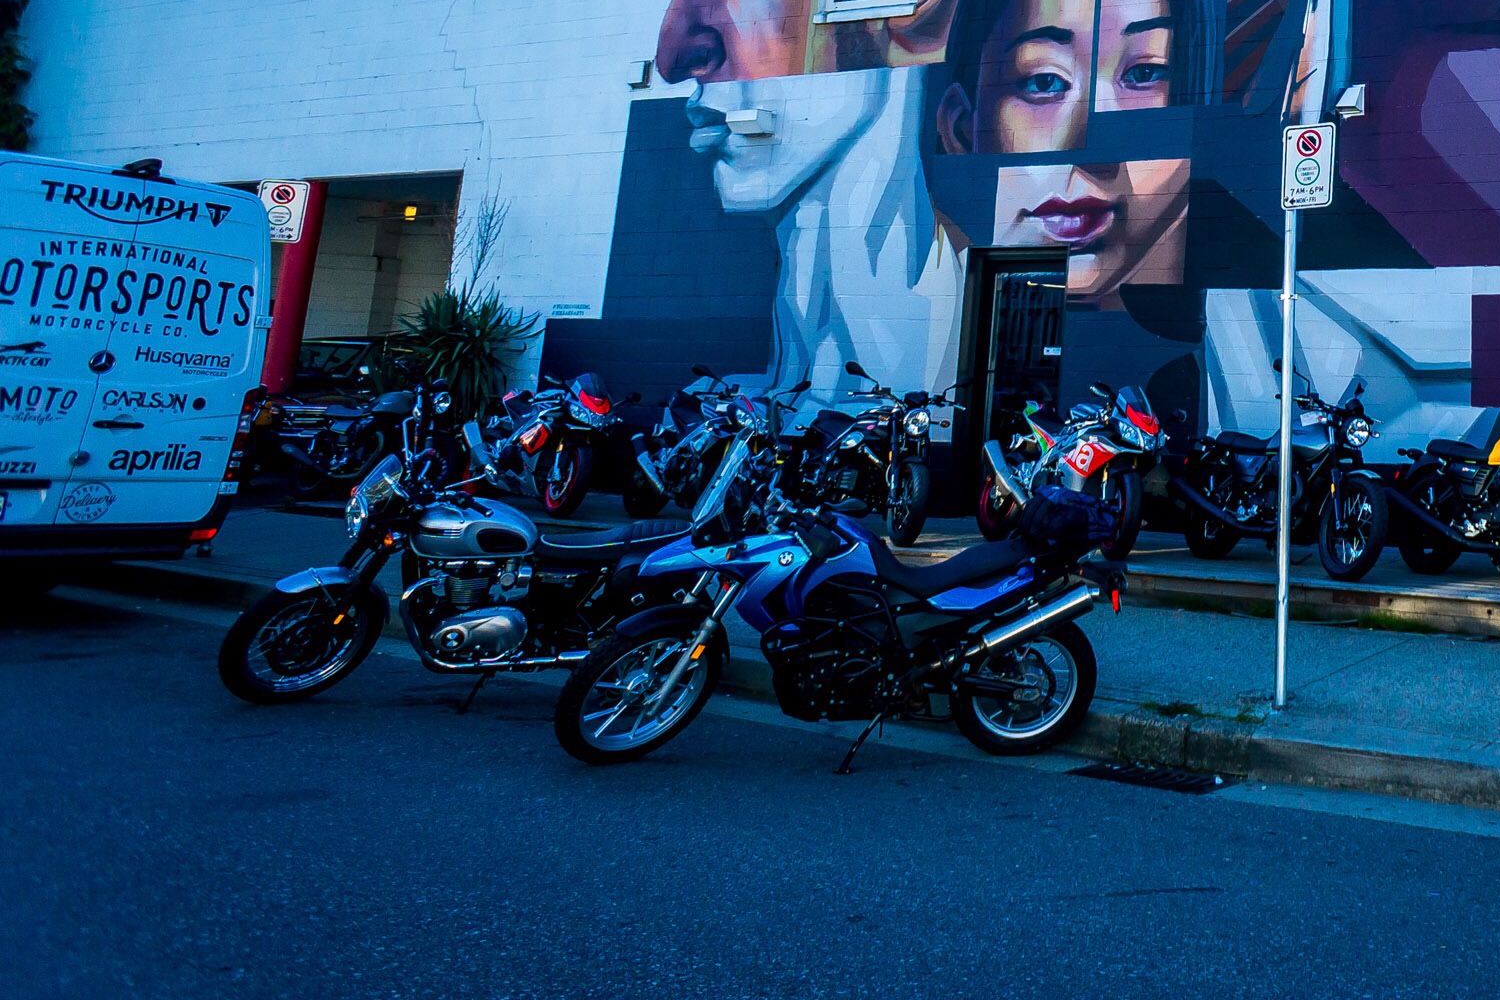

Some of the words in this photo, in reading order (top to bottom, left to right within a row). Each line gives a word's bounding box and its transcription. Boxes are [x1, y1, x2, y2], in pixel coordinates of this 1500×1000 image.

[41, 180, 198, 224] TRIUMPH
[40, 240, 208, 275] INTERNATIONAL
[0, 258, 254, 336] OTORSPORTS
[29, 314, 152, 334] MOTORCYCLE
[163, 325, 188, 338] CO.
[0, 355, 29, 366] RCTIC
[30, 356, 52, 367] CAT
[134, 345, 231, 368] Husqvarna
[182, 369, 228, 377] MOTORCYCLES
[0, 386, 78, 415] MOTO
[102, 389, 188, 414] CARLSON
[0, 461, 37, 474] UZZI
[108, 444, 202, 475] aprilia
